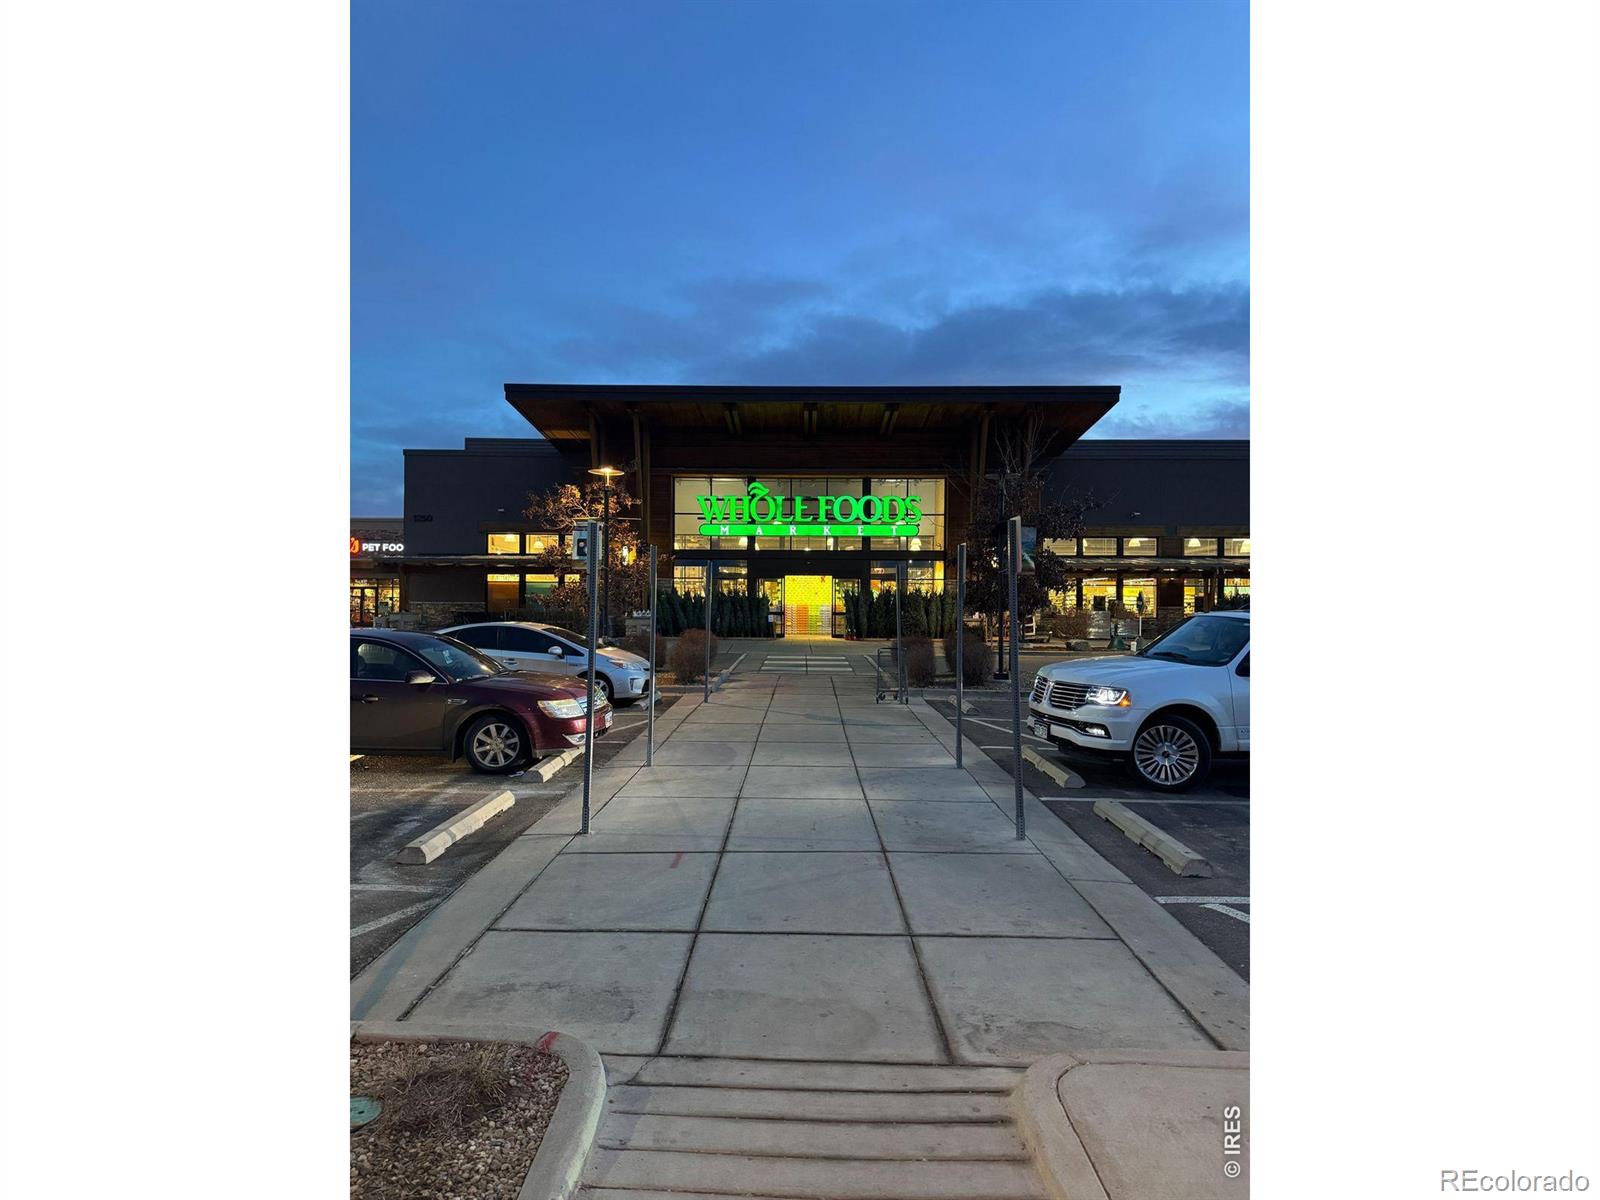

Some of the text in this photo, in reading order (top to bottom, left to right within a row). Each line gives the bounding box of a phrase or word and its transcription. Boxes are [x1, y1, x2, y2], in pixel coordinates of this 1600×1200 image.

[697, 494, 922, 523] WHOLE FOODS
[720, 525, 899, 536] MARKET
[362, 543, 380, 552] PET
